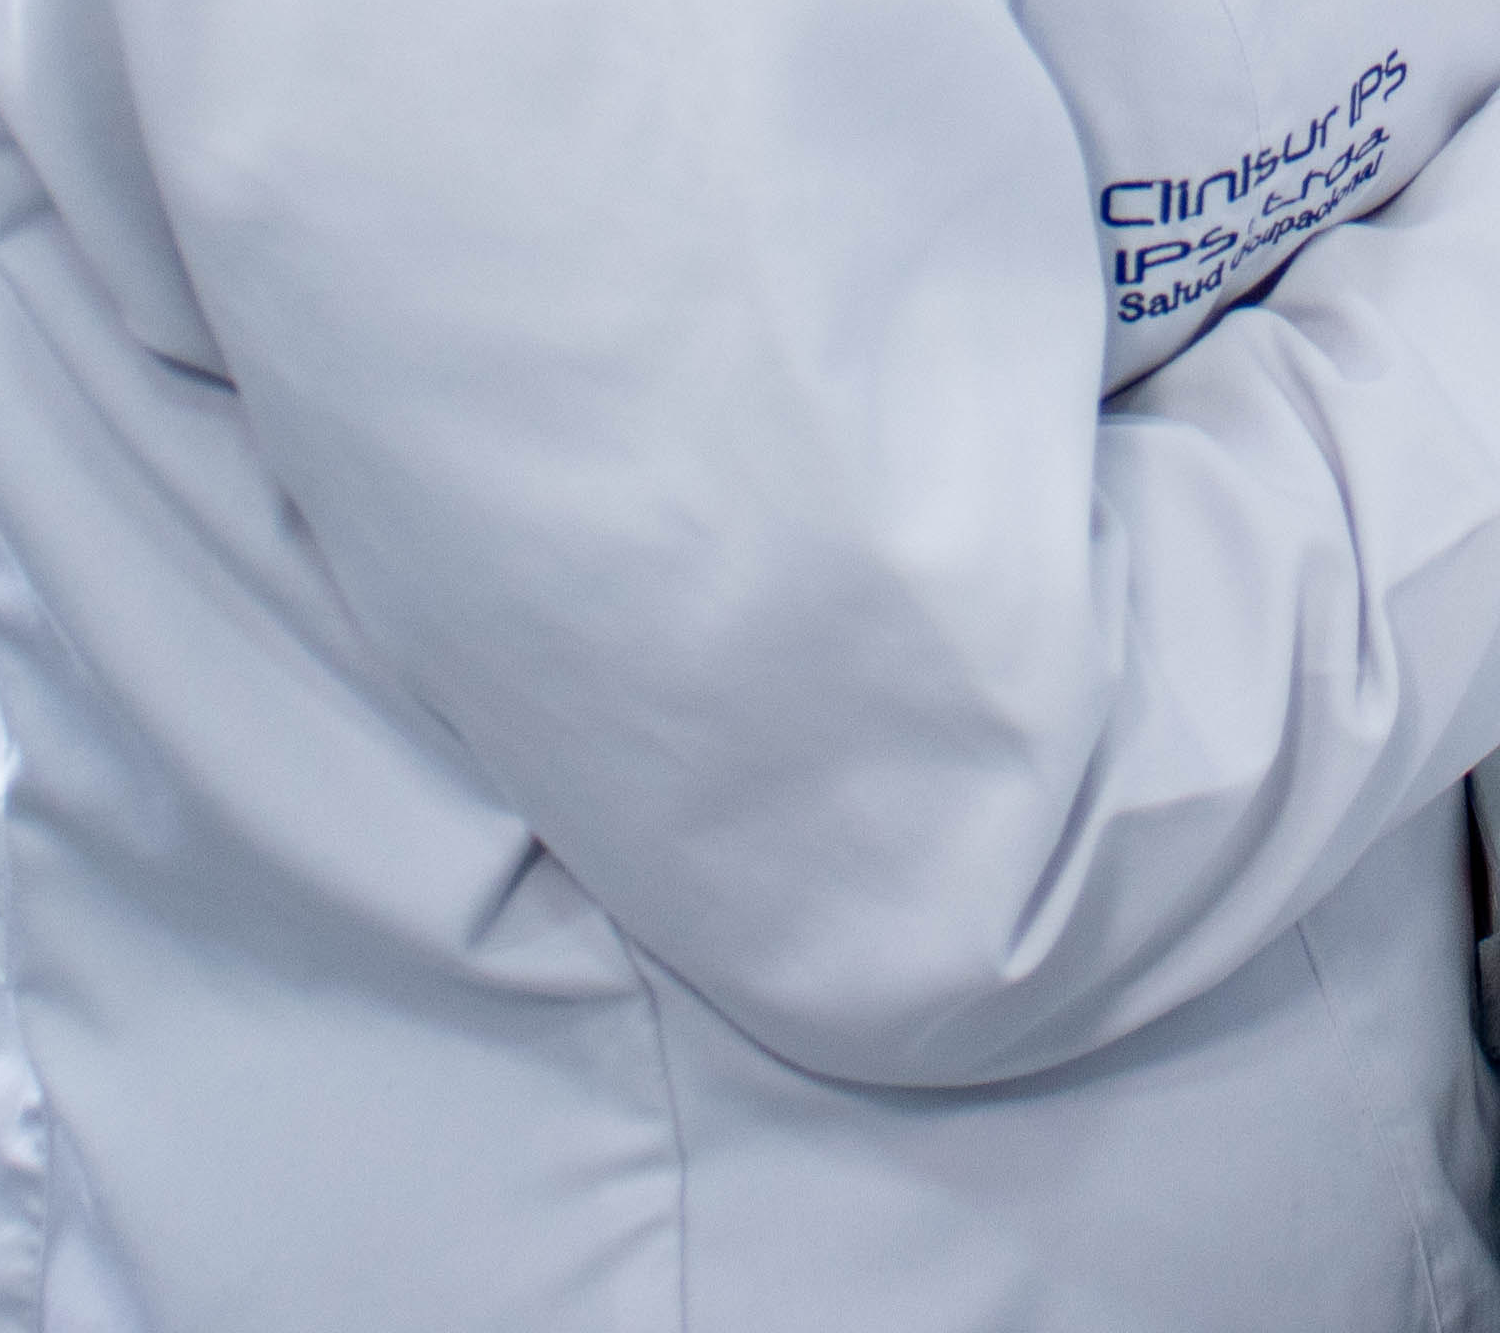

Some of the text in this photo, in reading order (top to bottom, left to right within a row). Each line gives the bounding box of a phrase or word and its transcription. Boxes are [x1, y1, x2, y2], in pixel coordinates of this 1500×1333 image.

[1349, 49, 1407, 129] IPS
[1115, 226, 1239, 285] IPS
[1117, 261, 1225, 323] Salud
